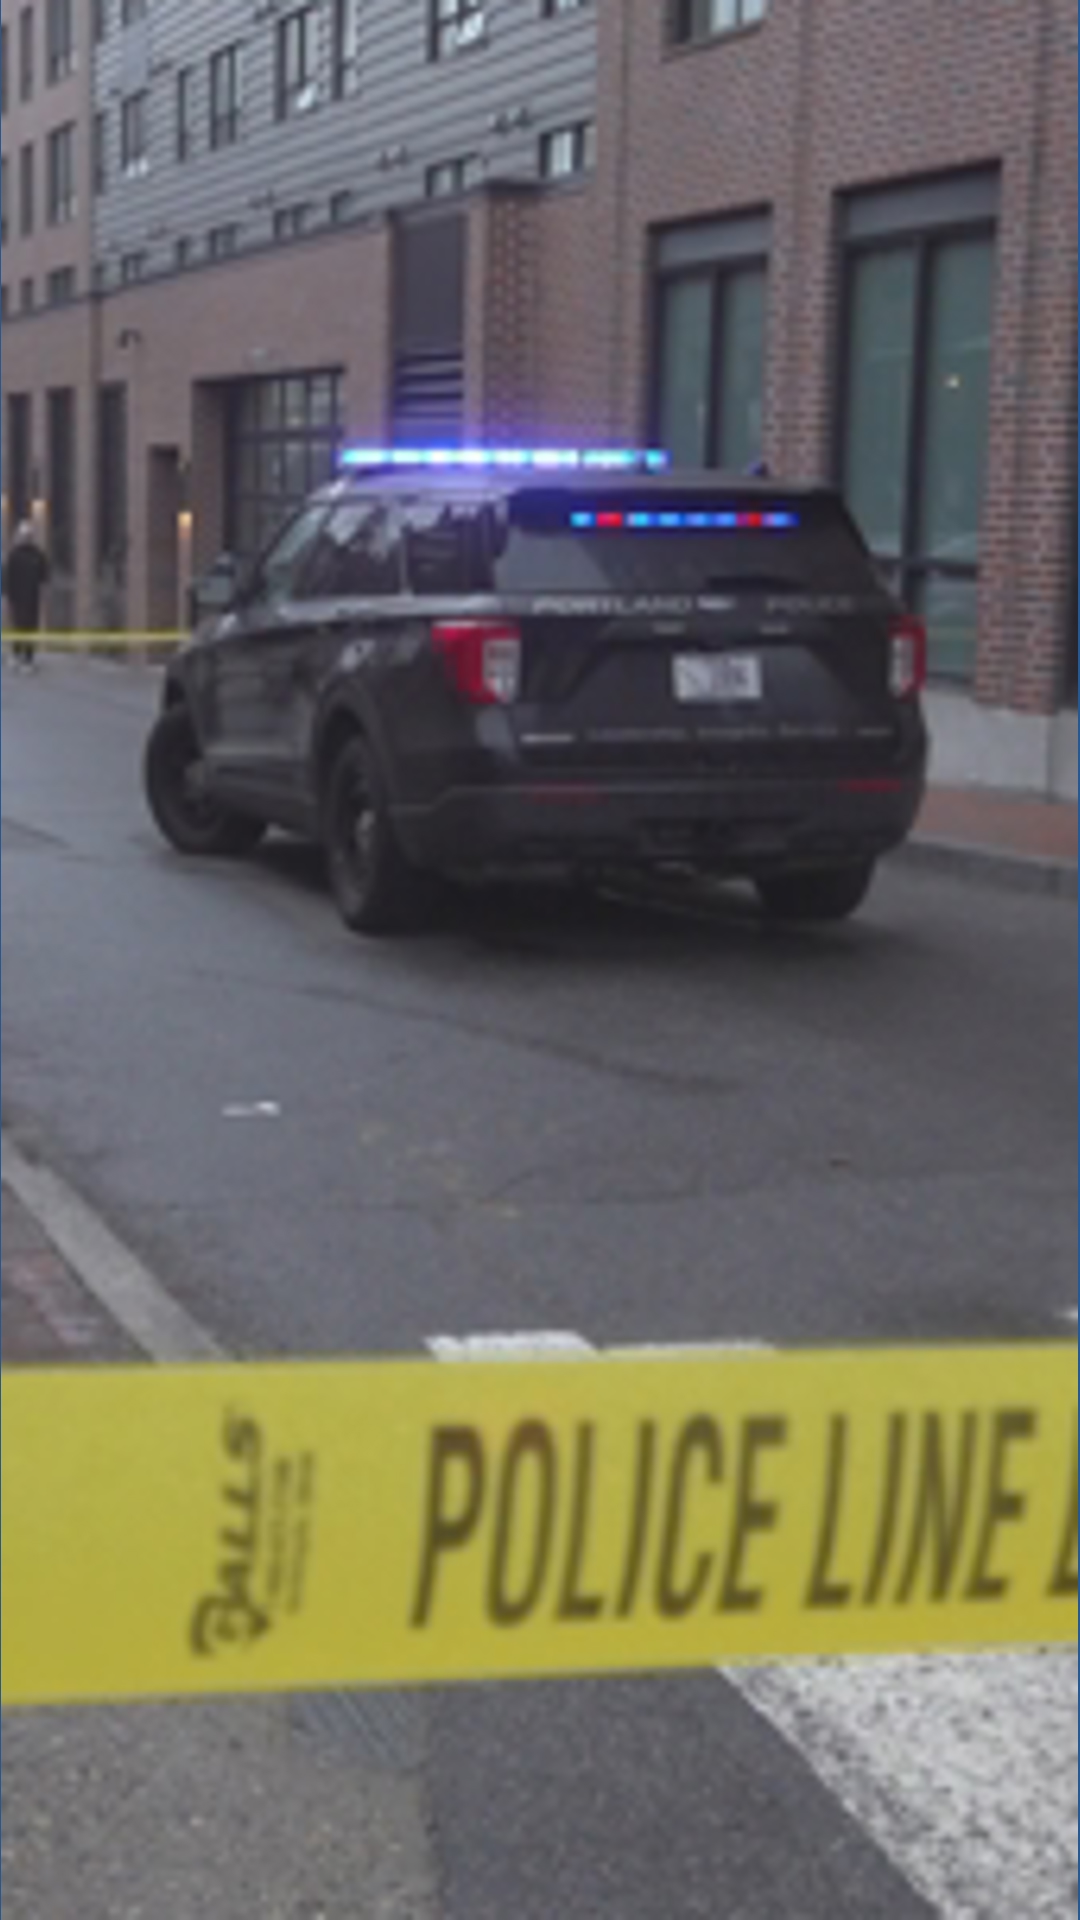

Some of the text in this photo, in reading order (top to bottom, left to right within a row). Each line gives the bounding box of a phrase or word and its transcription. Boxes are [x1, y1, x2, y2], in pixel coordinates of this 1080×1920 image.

[532, 595, 693, 614] PORTLAND
[409, 1412, 787, 1630] POLICE
[804, 1407, 1038, 1609] LINE
